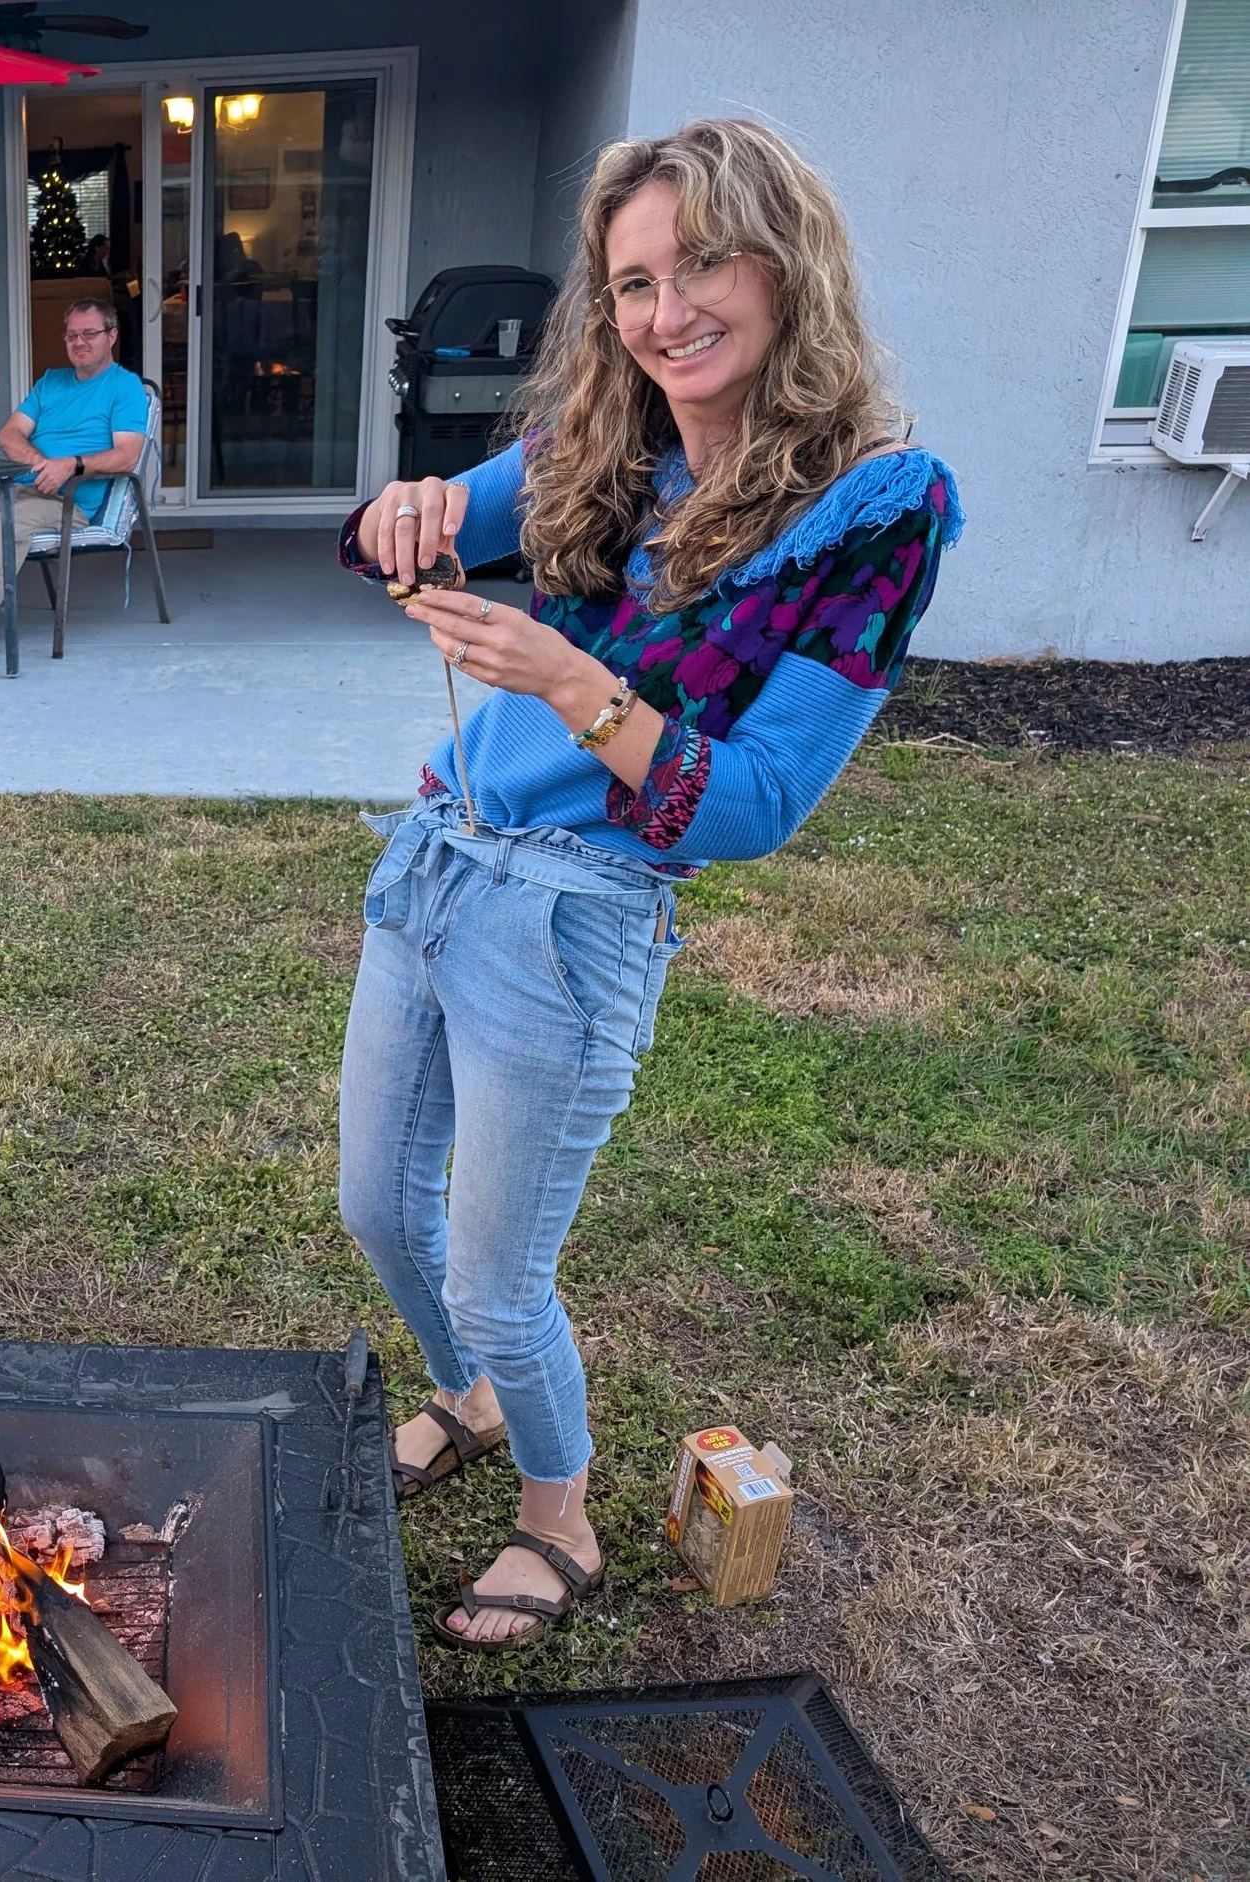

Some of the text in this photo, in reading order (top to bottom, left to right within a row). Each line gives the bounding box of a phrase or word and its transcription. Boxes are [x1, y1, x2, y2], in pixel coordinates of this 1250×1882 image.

[703, 1434, 731, 1444] ROYAL
[713, 1440, 731, 1448] OAK
[705, 1446, 753, 1462] TUMBLEWEEDS
[672, 1448, 690, 1515] TUMBLEWEEDS
